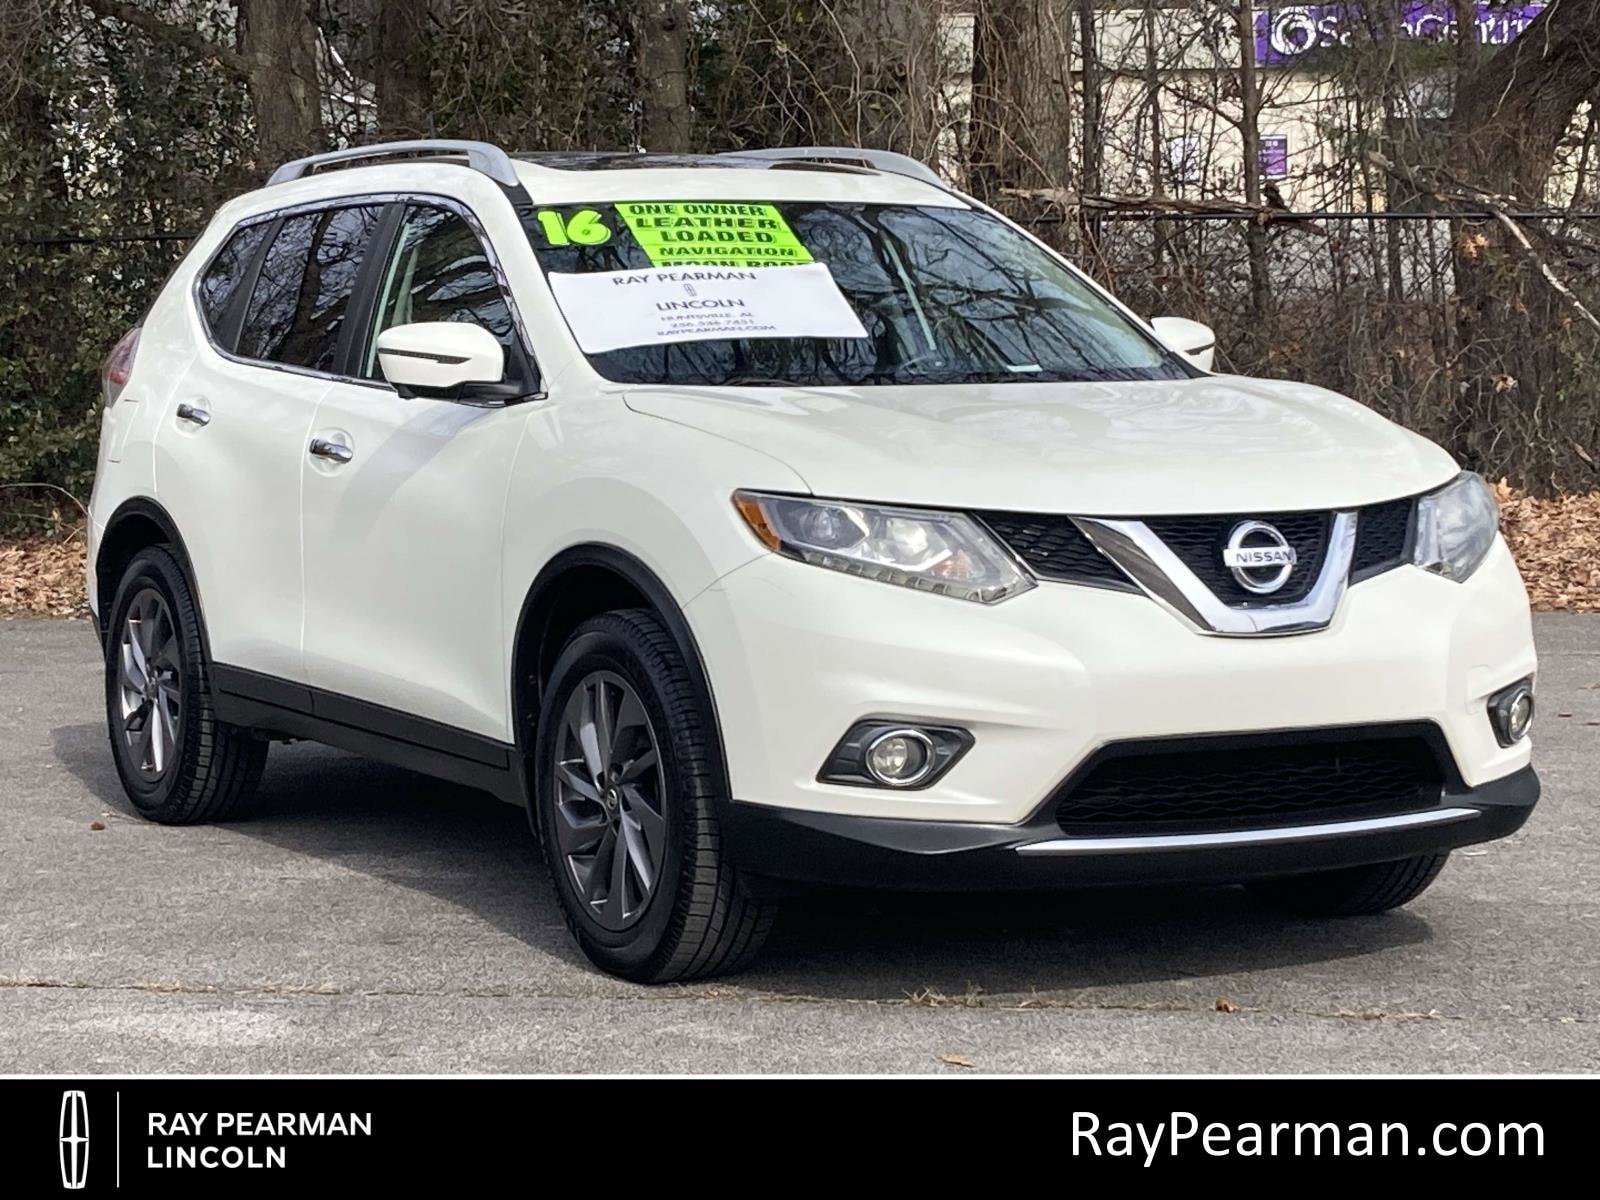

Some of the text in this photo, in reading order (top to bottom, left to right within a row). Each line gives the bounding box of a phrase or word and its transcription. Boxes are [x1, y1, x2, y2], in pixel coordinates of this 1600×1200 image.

[629, 205, 765, 216] ONE OWNER
[538, 210, 611, 245] 16
[636, 217, 778, 230] LEATHER
[661, 230, 774, 243] LOADED
[660, 246, 795, 256] NAVIGATION
[612, 272, 757, 285] RAY PEARMAN
[656, 299, 746, 311] LINCOLN
[1236, 551, 1292, 563] NISSAN
